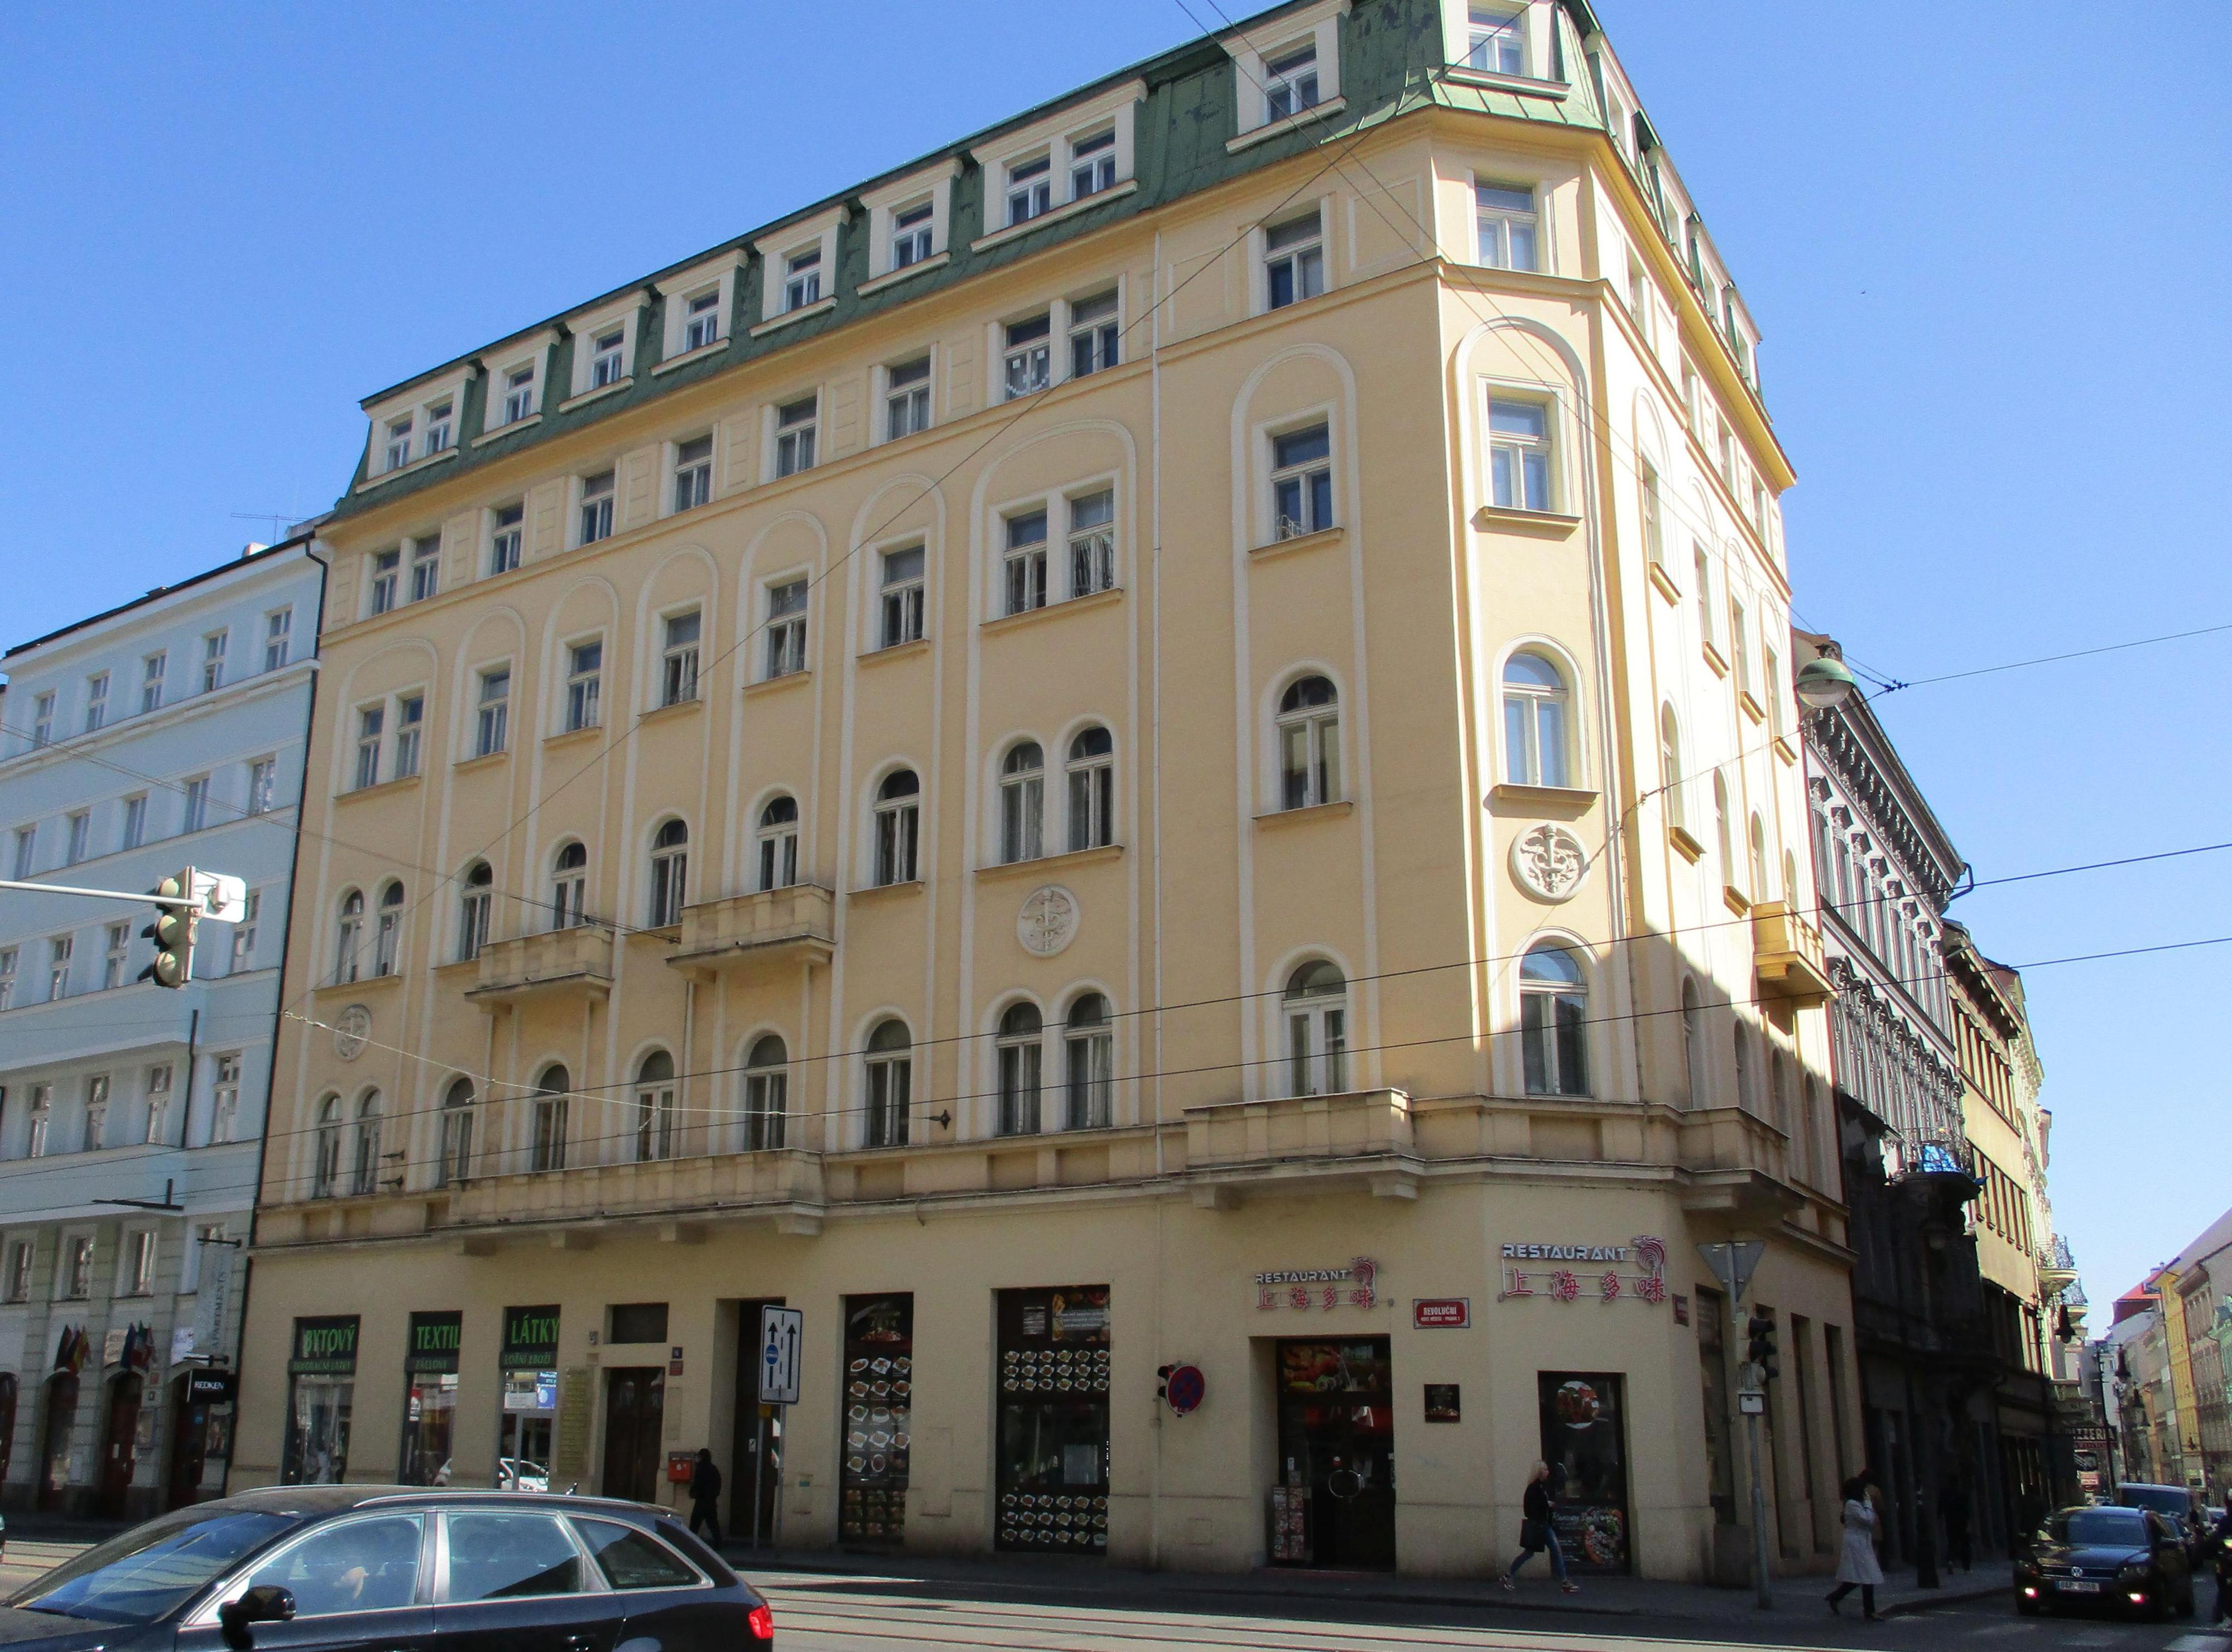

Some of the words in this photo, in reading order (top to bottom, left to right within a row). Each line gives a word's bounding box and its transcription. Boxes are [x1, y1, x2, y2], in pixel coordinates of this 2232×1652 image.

[1502, 1242, 1627, 1261] RESTAURANT
[1255, 1269, 1348, 1284] RESTAURANT
[1505, 1268, 1668, 1303] 上海多味
[1256, 1285, 1374, 1311] 上海多味
[1423, 1305, 1457, 1316] REVOLUČNÍ
[304, 1324, 355, 1352] BYTOVÝ
[417, 1325, 460, 1349] TEXTIL
[512, 1313, 559, 1343] LÁTKY
[194, 1381, 224, 1389] REDKEN
[2067, 1428, 2115, 1440] IZZERIA
